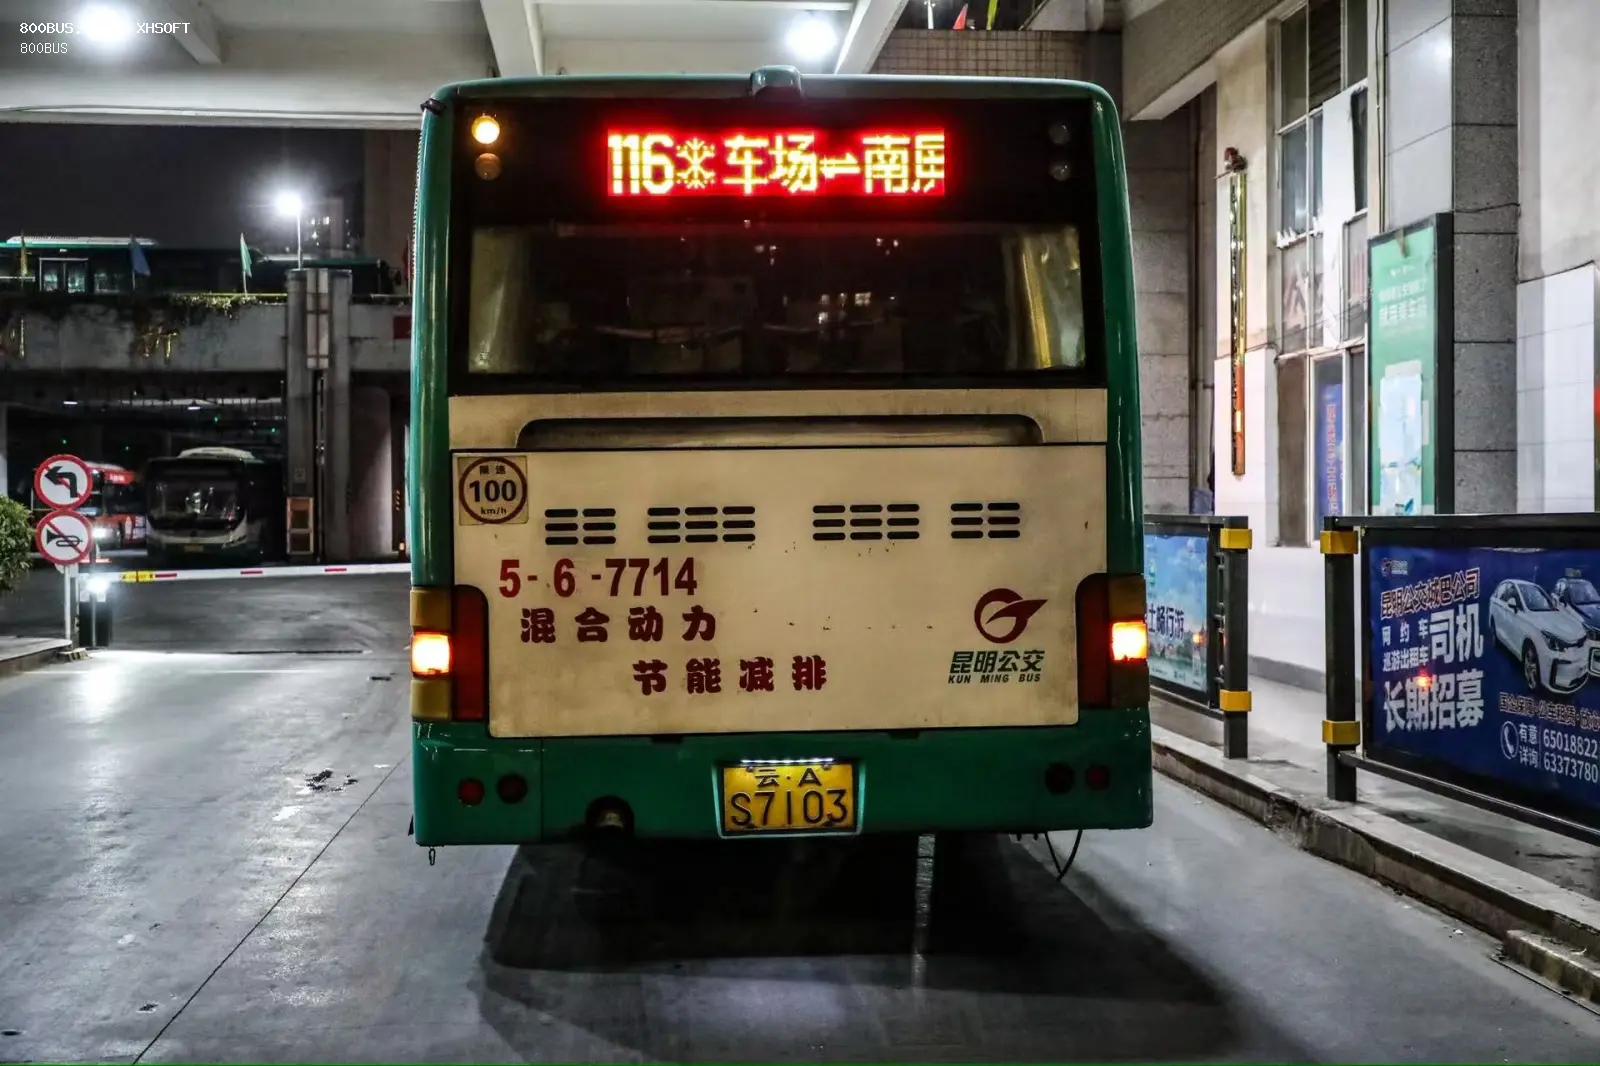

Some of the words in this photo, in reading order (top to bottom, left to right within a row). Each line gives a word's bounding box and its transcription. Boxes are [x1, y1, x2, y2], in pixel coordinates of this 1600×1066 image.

[608, 134, 674, 194] 116
[724, 134, 817, 194] 车场
[469, 479, 517, 503] 100
[480, 506, 507, 515] km/h
[520, 605, 716, 643] 混合动力
[1430, 602, 1484, 664] 司机
[950, 649, 1046, 674] 昆明公交
[1382, 645, 1429, 672] 巡游出租车
[632, 655, 827, 696] 节能减排
[948, 674, 972, 684] KUN
[980, 674, 1010, 683] MING
[1018, 673, 1041, 683] BUS
[1383, 667, 1484, 733] 长期招募
[1518, 722, 1538, 745] 有意
[1519, 745, 1539, 768] 详询
[730, 788, 848, 826] S7103
